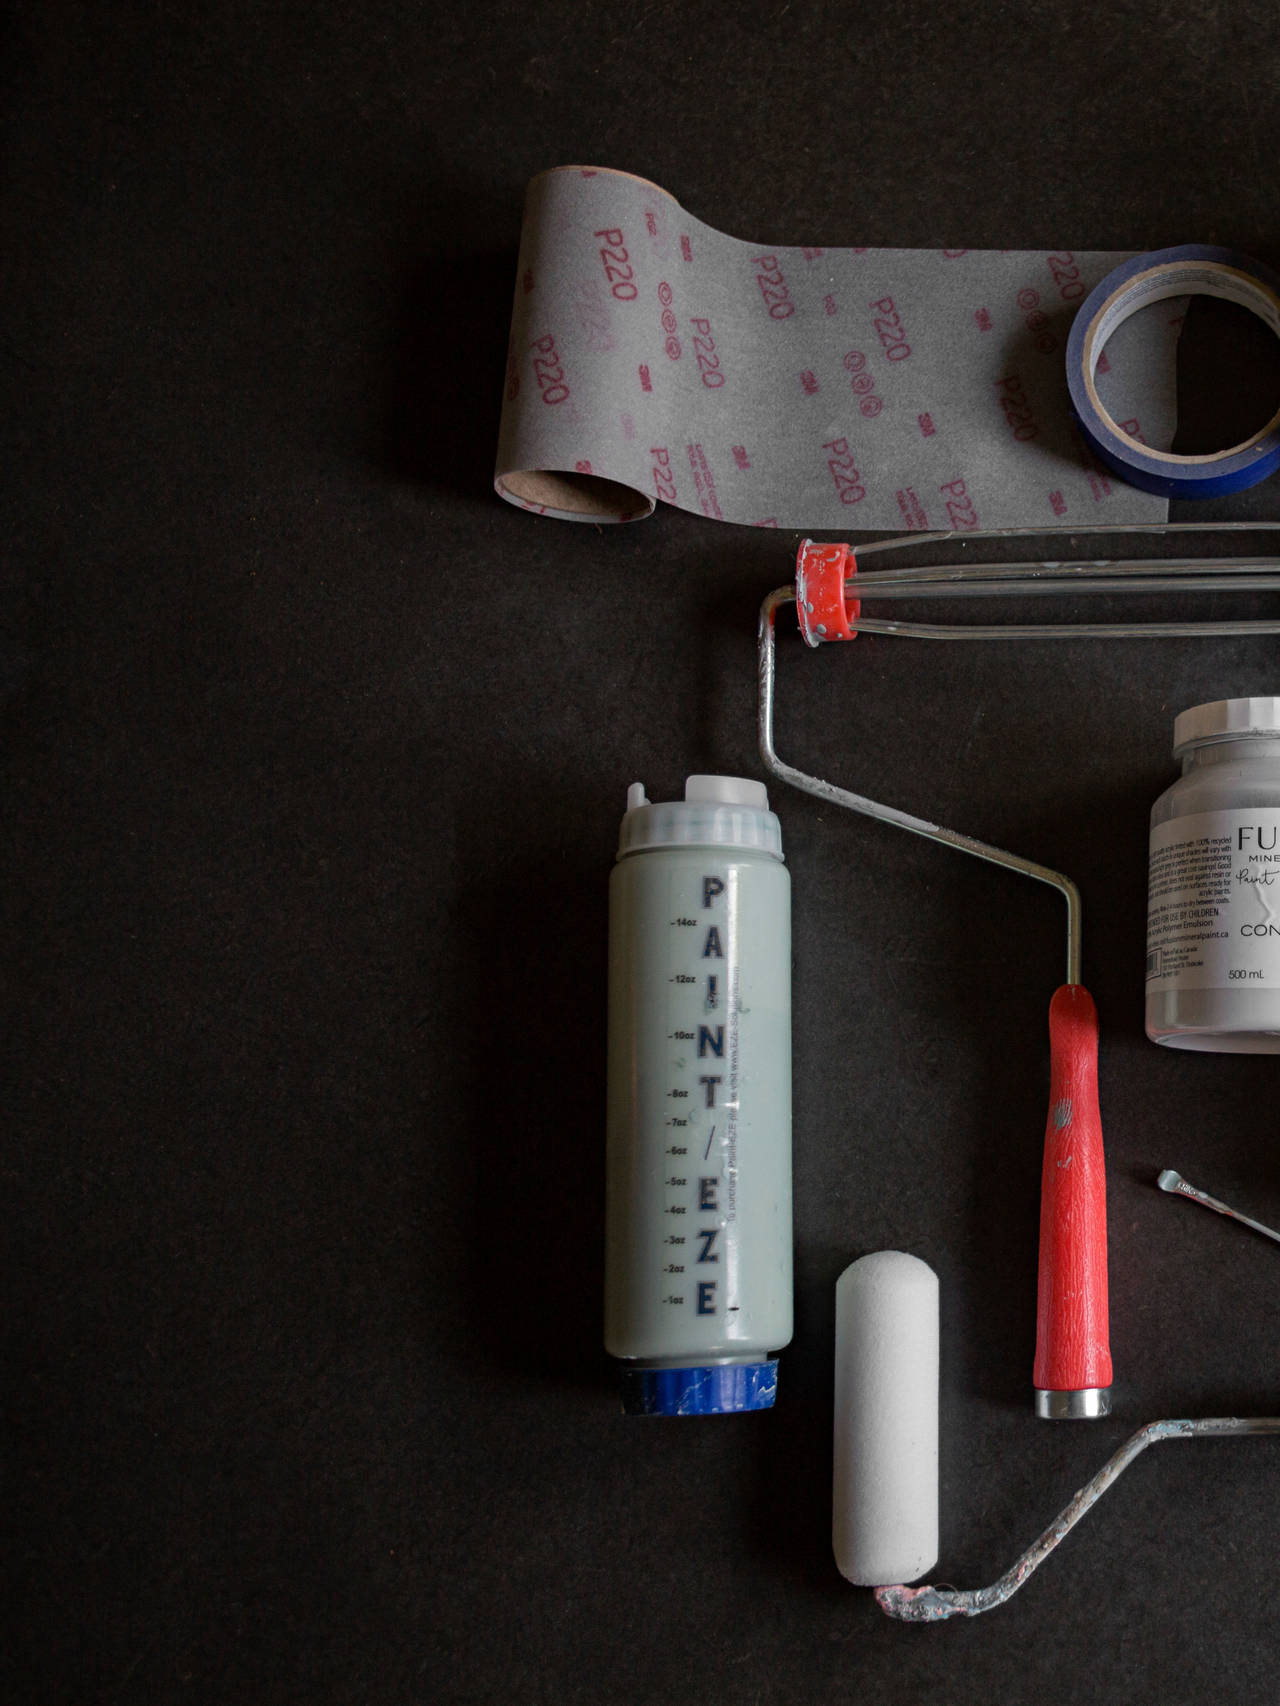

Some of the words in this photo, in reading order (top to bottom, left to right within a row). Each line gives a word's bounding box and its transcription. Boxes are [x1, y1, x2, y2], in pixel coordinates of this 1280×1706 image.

[594, 228, 638, 301] P220
[750, 255, 795, 320] P220
[690, 317, 725, 388] P220
[868, 296, 912, 361] P220
[530, 334, 571, 404] P220
[650, 448, 677, 501] P22
[822, 437, 866, 504] P220
[940, 479, 979, 531] P22
[1189, 907, 1219, 919] CHILDREN
[1228, 969, 1247, 980] 500
[1249, 969, 1265, 980] mL
[728, 1092, 738, 1121] plese
